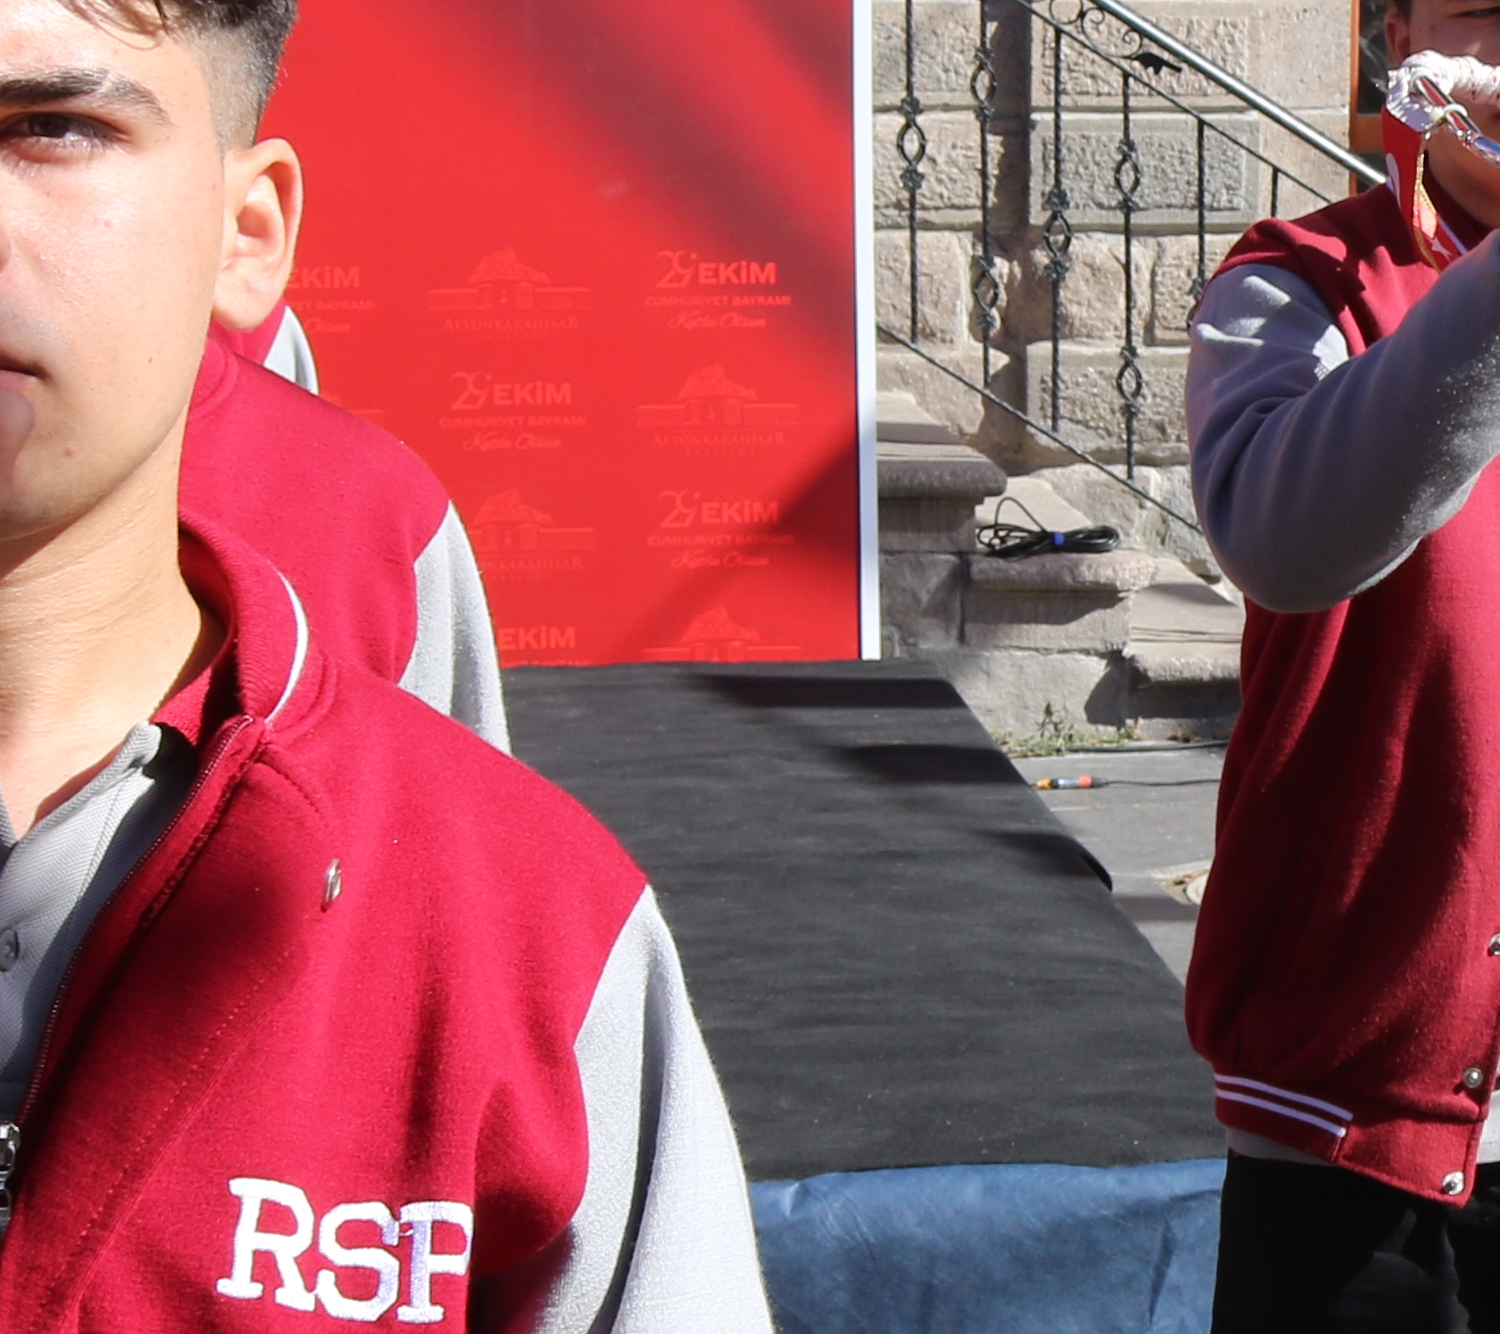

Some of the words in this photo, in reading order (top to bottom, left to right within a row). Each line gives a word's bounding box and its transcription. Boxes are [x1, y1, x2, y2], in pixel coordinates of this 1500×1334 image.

[698, 261, 776, 284] EKİM
[493, 381, 573, 405] EKİM
[498, 626, 577, 650] EKİM
[216, 1177, 474, 1325] RSP
